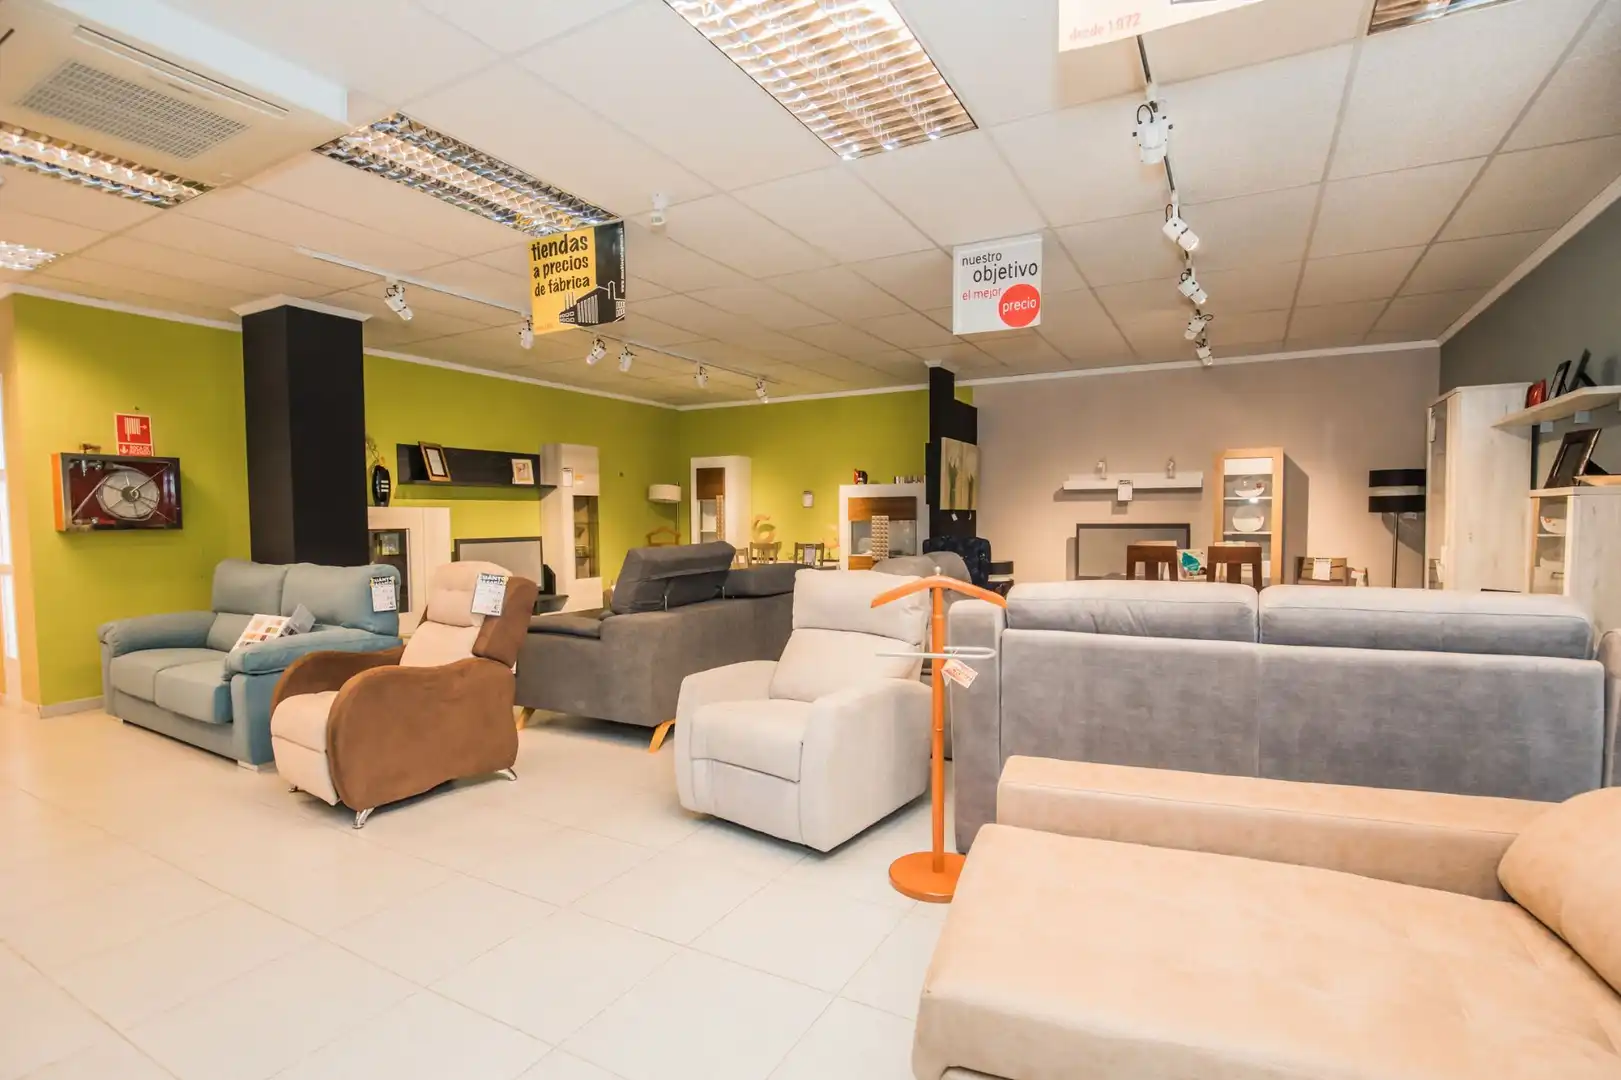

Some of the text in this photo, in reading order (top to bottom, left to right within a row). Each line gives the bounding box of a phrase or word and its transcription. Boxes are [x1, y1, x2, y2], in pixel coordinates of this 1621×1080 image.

[531, 234, 588, 261] tiendas
[533, 256, 589, 279] a precios
[962, 252, 1002, 266] nuestro
[973, 261, 1038, 284] objetivo
[535, 276, 590, 297] de fábrica
[962, 288, 1002, 300] el mejor
[1002, 297, 1037, 315] precio
